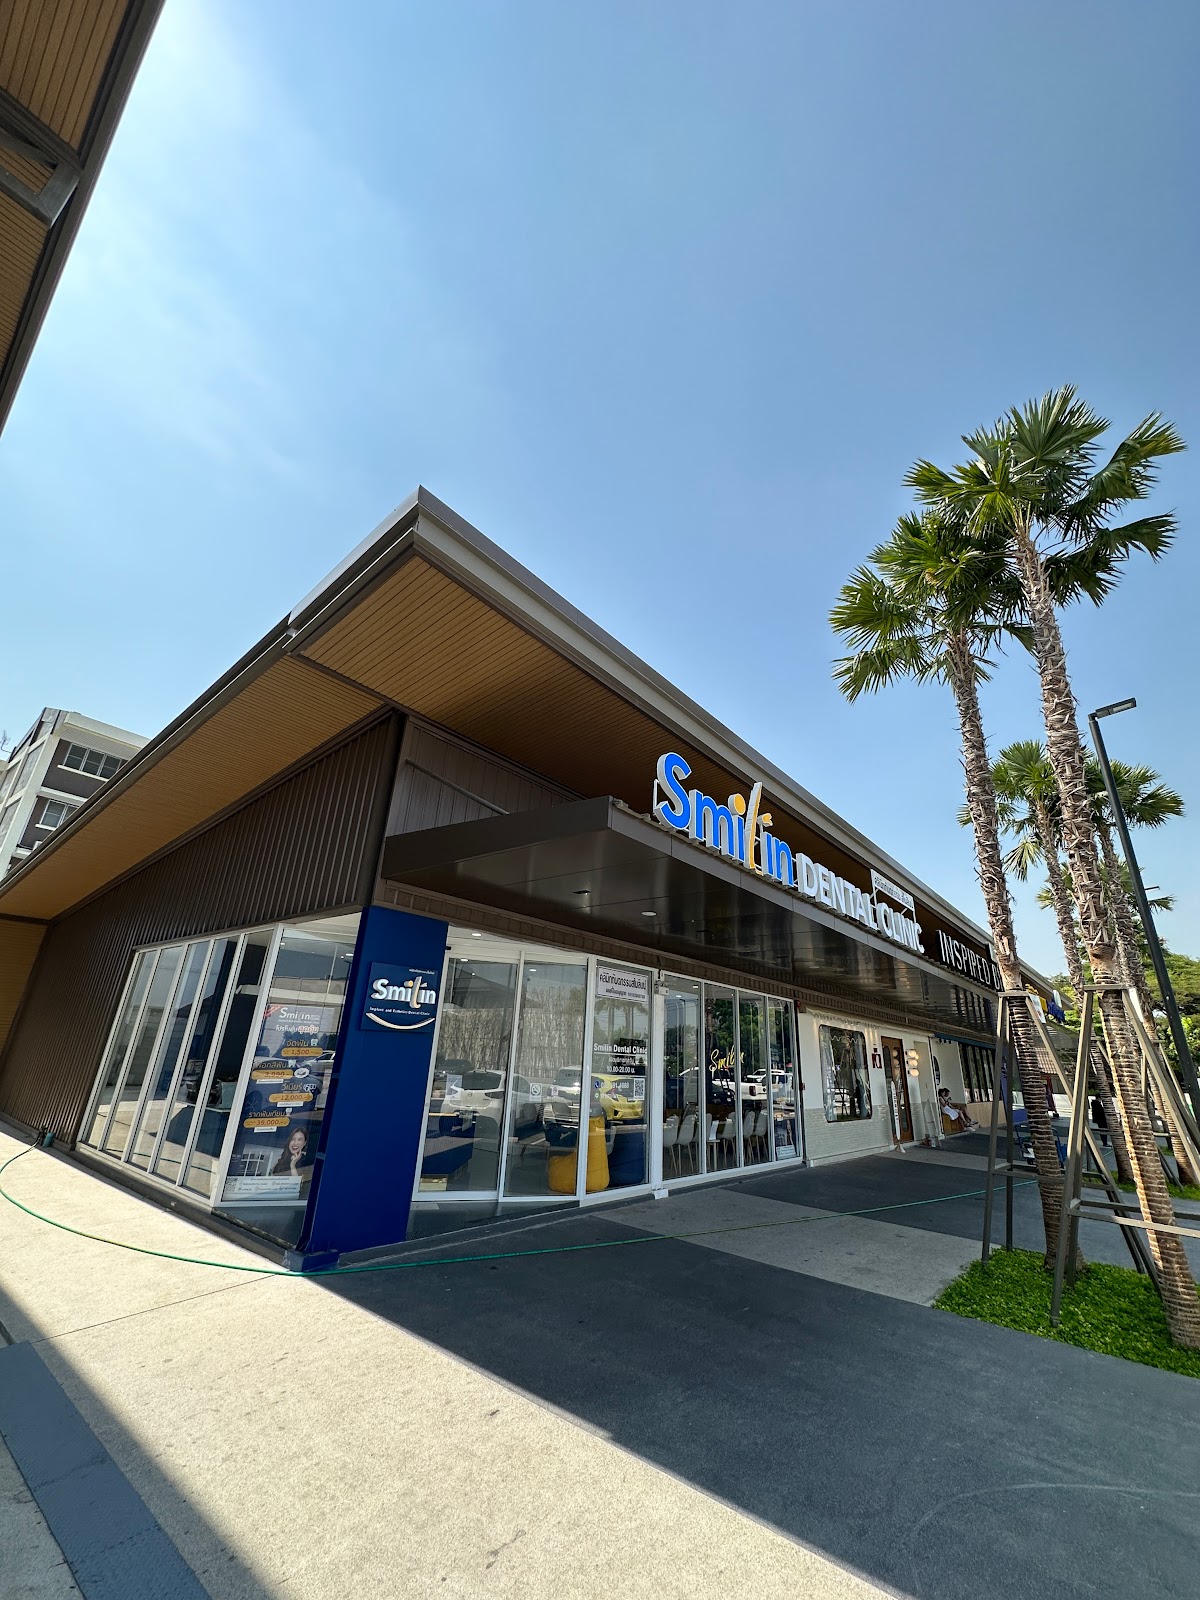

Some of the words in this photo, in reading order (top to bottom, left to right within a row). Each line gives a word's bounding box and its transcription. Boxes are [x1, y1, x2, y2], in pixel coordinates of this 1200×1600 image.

[654, 752, 794, 887] Smilin
[796, 853, 878, 931] DENTAL
[876, 903, 925, 954] CLINIC
[936, 930, 991, 985] INSPIRED
[371, 976, 436, 1008] Smilin
[279, 1007, 311, 1020] Smilin
[613, 1045, 632, 1053] Dental
